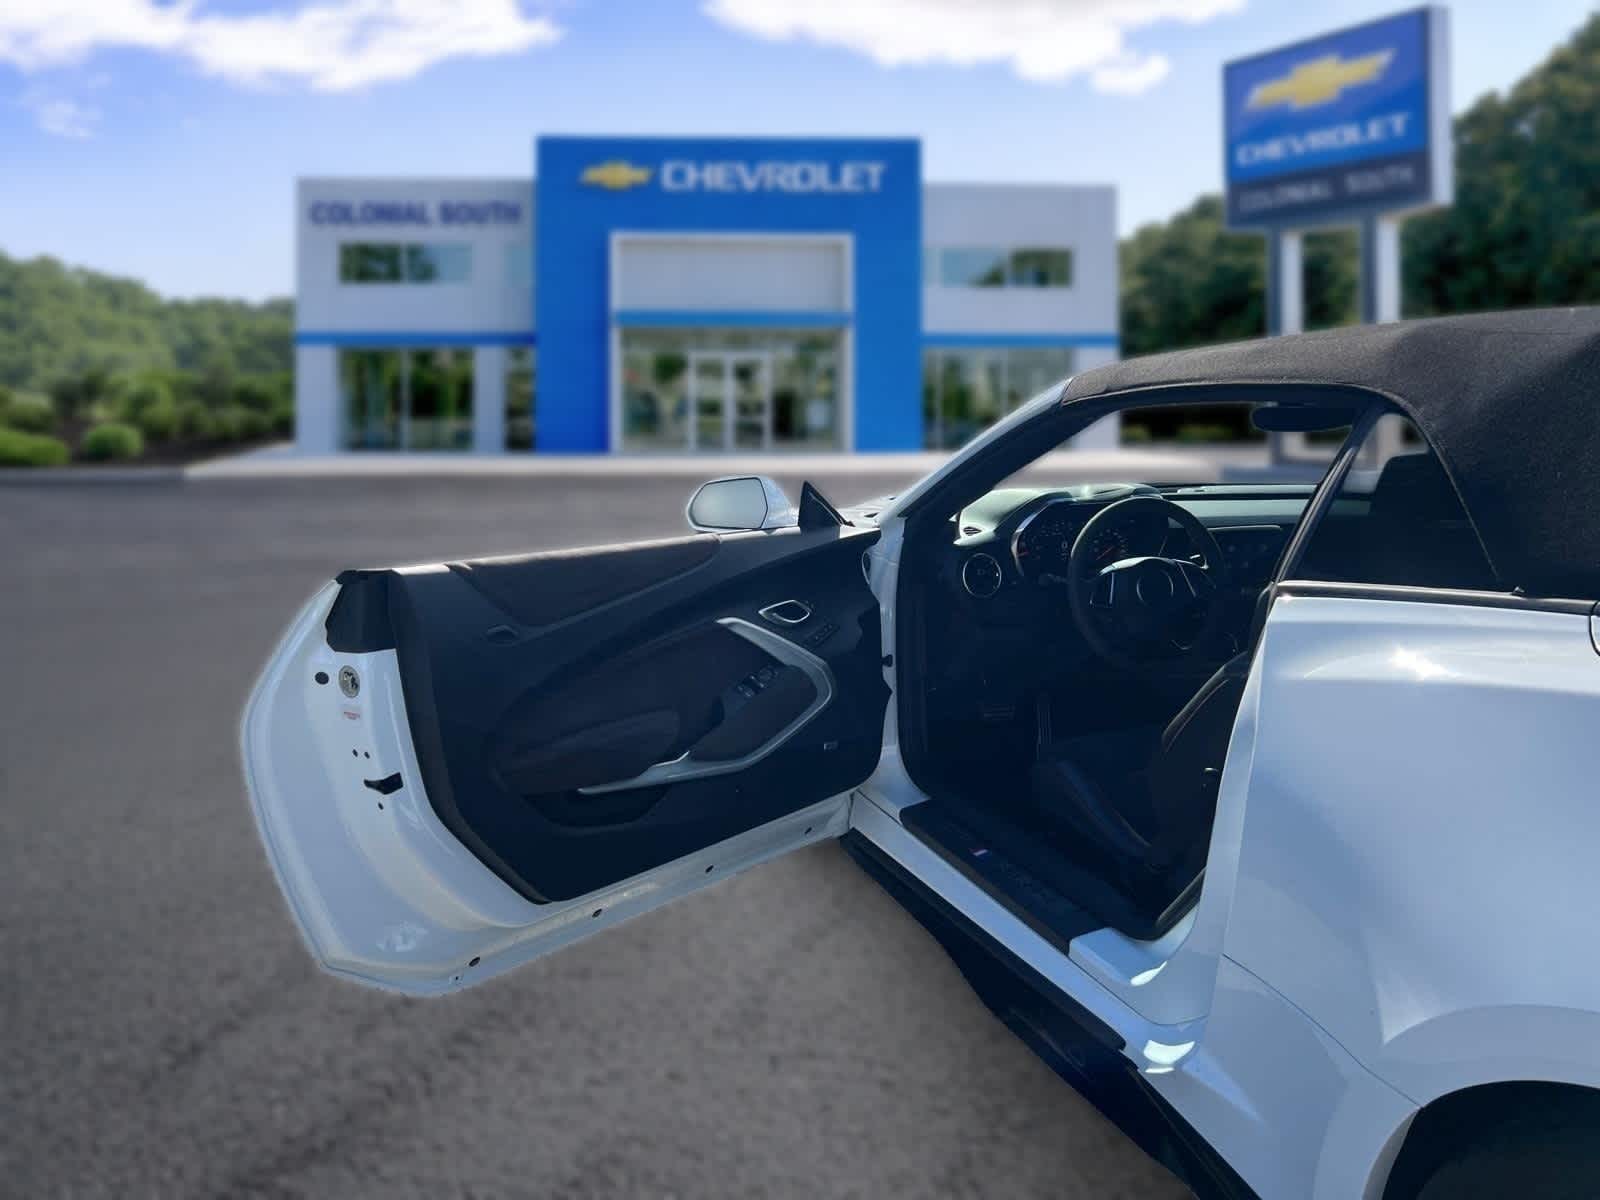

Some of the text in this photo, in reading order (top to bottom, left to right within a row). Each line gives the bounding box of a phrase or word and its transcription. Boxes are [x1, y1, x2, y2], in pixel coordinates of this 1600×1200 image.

[1236, 112, 1412, 168] CHEVROLET
[661, 159, 885, 193] CHEVROLET
[308, 199, 523, 226] COLONIAL SOUTH
